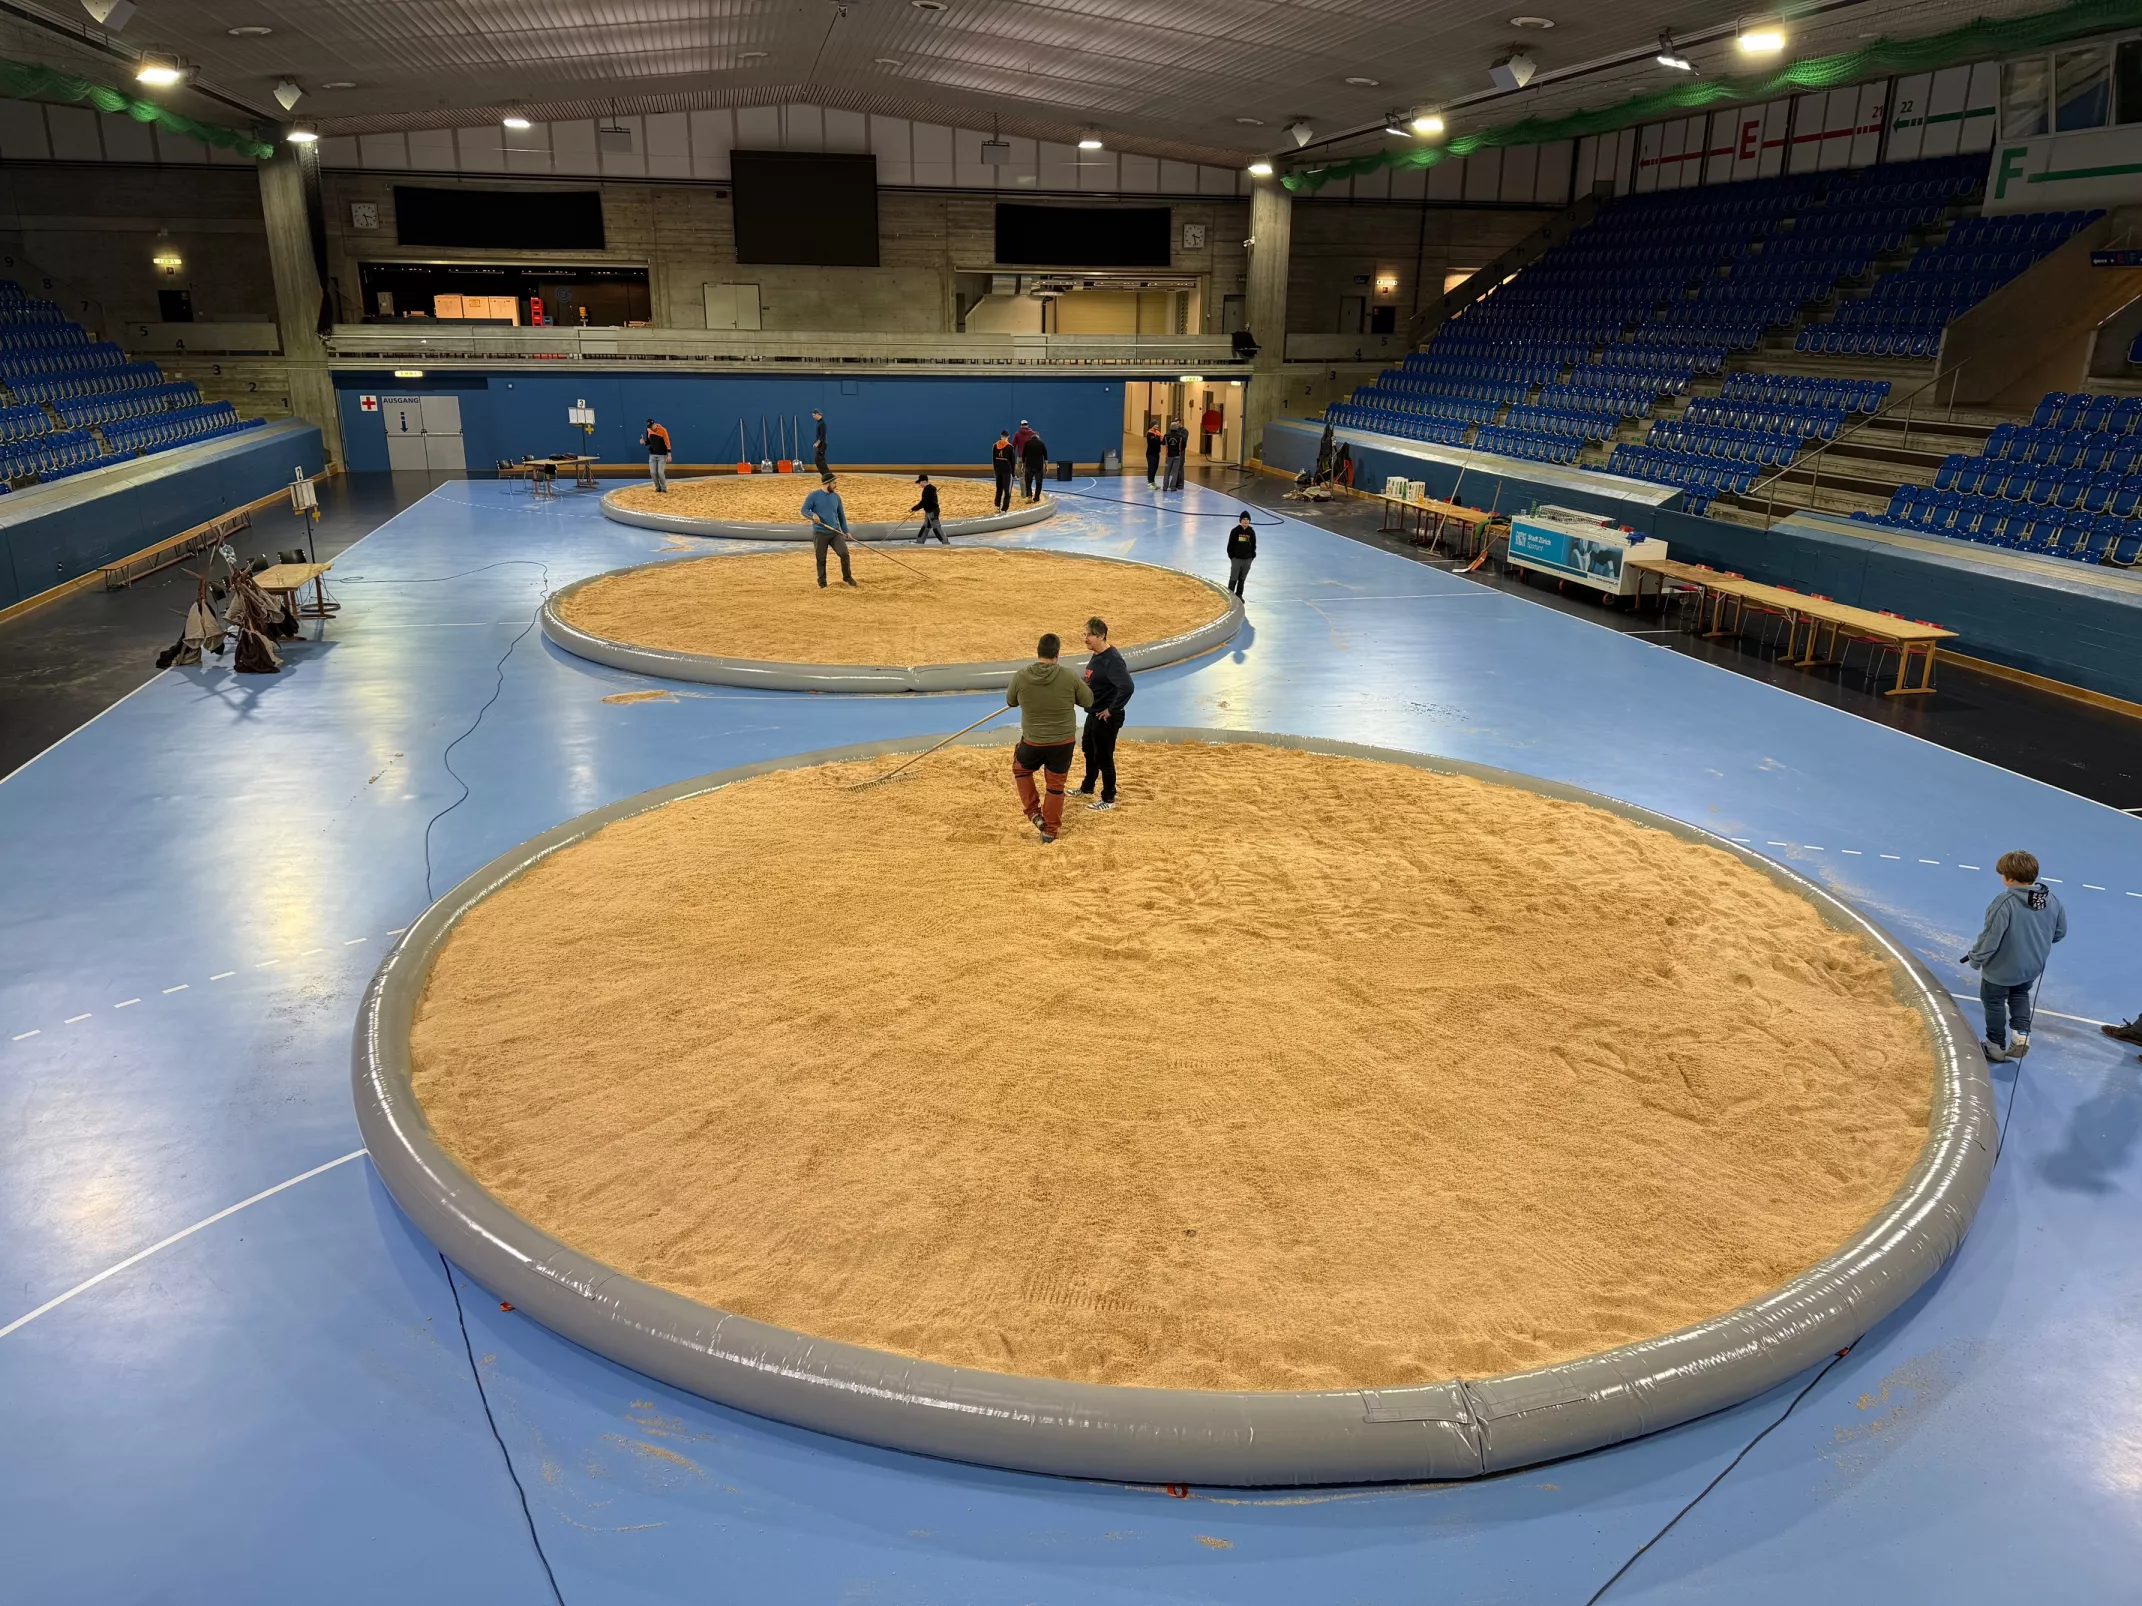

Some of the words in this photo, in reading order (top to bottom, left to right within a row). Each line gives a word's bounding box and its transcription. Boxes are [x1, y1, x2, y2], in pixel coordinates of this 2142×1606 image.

[1872, 105, 1883, 118] 21
[1900, 100, 1914, 114] 22
[1740, 120, 1760, 160] E
[1994, 147, 2028, 199] F
[1542, 228, 1552, 238] 12
[4, 256, 14, 267] 9
[1493, 263, 1504, 273] 10
[43, 278, 53, 289] 8
[81, 300, 89, 311] 7
[1420, 316, 1426, 325] 7
[140, 326, 148, 337] 5
[176, 339, 185, 350] 4
[1381, 337, 1388, 346] 5
[1355, 348, 1362, 357] 4
[212, 364, 221, 375] 3
[1330, 371, 1337, 380] 3
[249, 382, 258, 393] 2
[1305, 386, 1312, 395] 2
[281, 397, 288, 408] 1
[579, 400, 585, 408] 3
[1283, 399, 1288, 409] 1
[297, 468, 303, 480] 2
